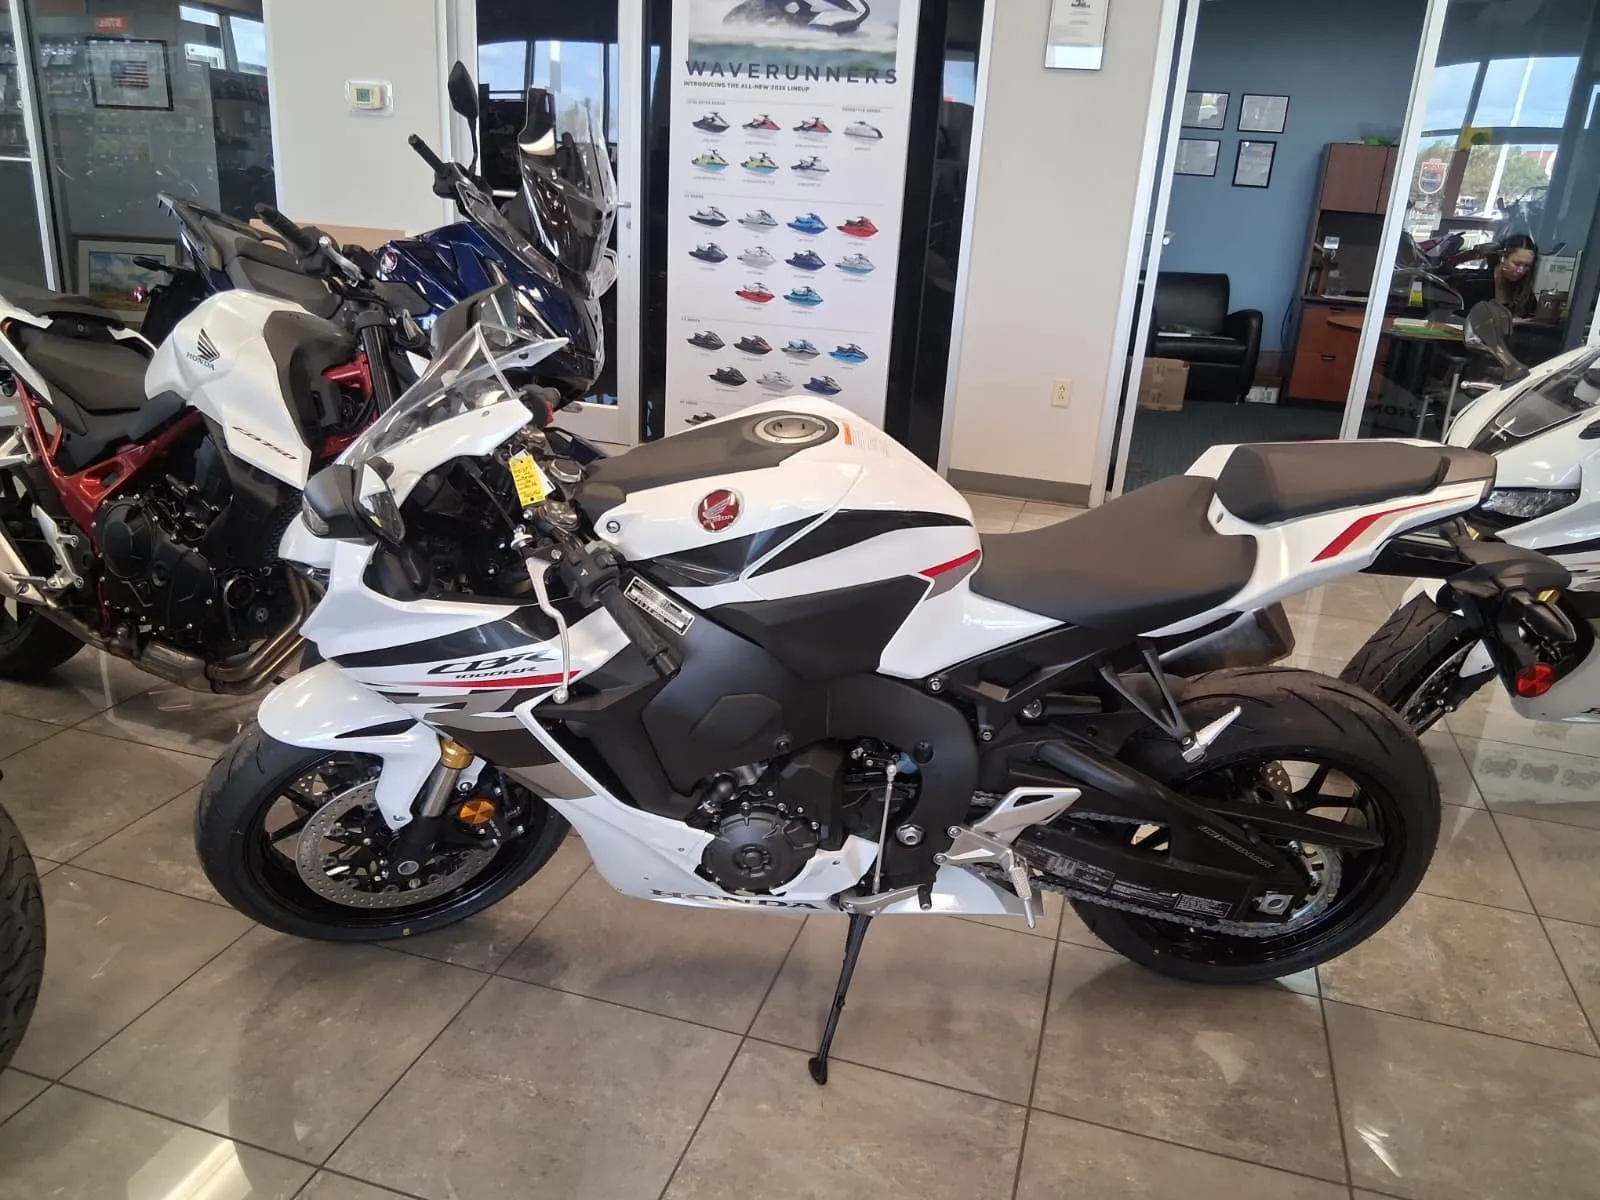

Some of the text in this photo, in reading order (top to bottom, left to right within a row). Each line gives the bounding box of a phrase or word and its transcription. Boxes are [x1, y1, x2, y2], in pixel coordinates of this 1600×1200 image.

[686, 60, 897, 85] WAVERUNNERS
[683, 80, 726, 89] INTRODUCING
[186, 351, 215, 371] HONDA
[427, 649, 559, 675] CBR
[455, 665, 541, 679] 1000RR
[647, 888, 825, 910] HONDA
